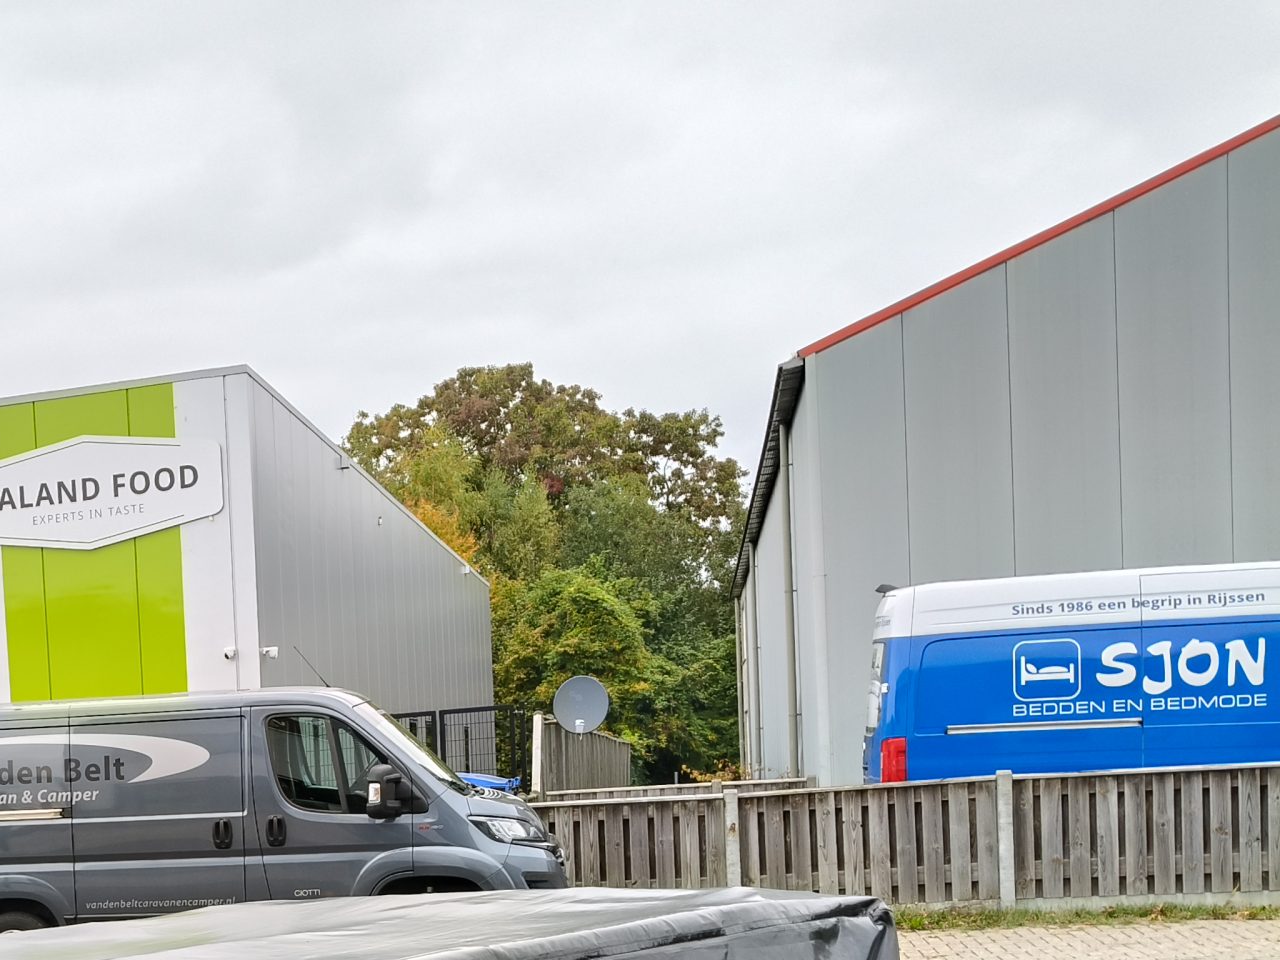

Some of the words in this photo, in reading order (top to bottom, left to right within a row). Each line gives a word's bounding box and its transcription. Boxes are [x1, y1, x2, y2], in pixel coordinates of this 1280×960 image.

[112, 464, 199, 498] FOOD
[32, 510, 85, 526] EXPERTS
[89, 508, 103, 519] IN
[107, 503, 145, 517] TASTE
[1011, 603, 1053, 616] Sinds
[1058, 600, 1094, 613] 1986
[1097, 599, 1127, 611] een
[1131, 594, 1183, 611] begrip
[1187, 594, 1202, 607] in
[1207, 590, 1265, 607] Rijssen
[1095, 637, 1266, 695] SJON
[1013, 700, 1106, 716] BEDDEN
[1113, 699, 1143, 712] EN
[1150, 693, 1267, 711] BEDMODE
[64, 755, 125, 783] Belt
[21, 790, 33, 804] &
[37, 787, 100, 806] Camper
[86, 896, 236, 909] vandenbeltcaravanencamper.nl
